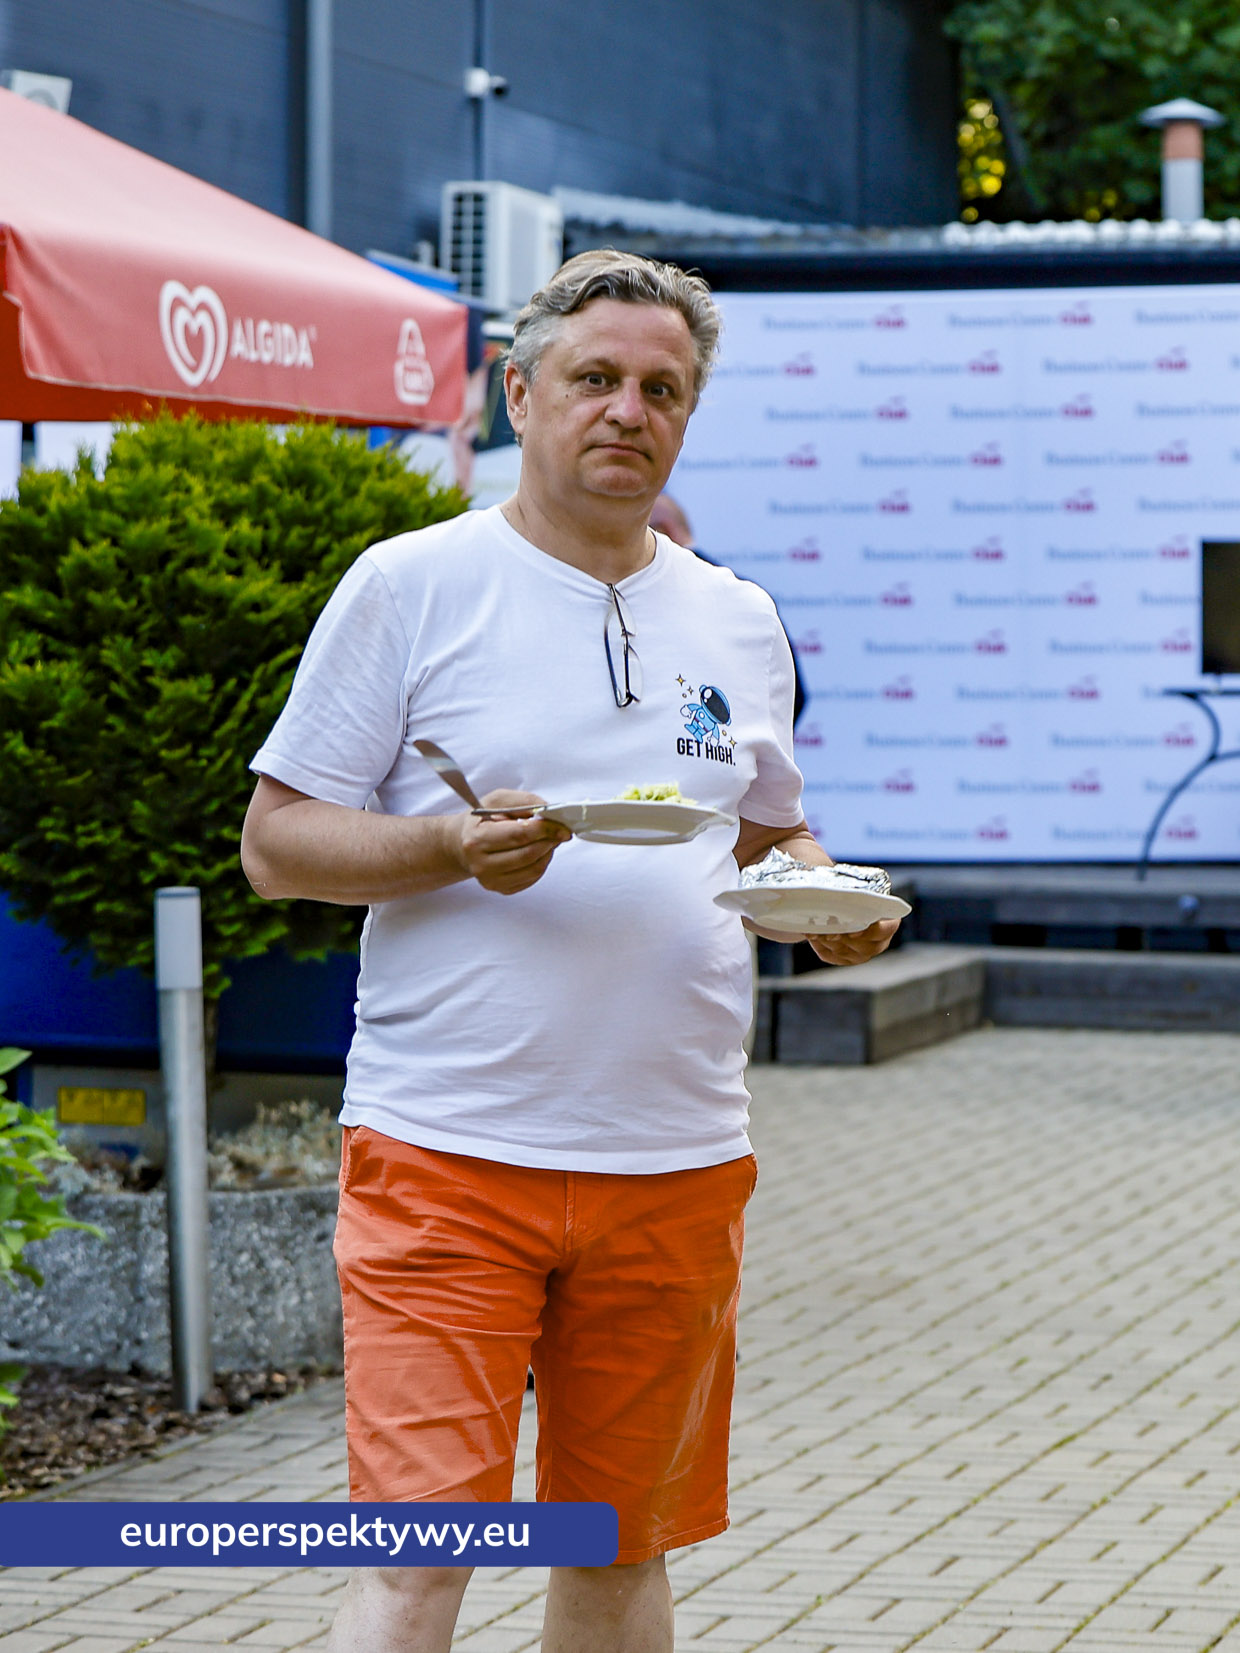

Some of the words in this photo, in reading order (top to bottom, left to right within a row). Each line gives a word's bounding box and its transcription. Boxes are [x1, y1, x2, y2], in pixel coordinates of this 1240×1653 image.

[230, 317, 314, 369] ALGIDA
[677, 737, 701, 758] GET
[705, 741, 736, 767] HIGH.
